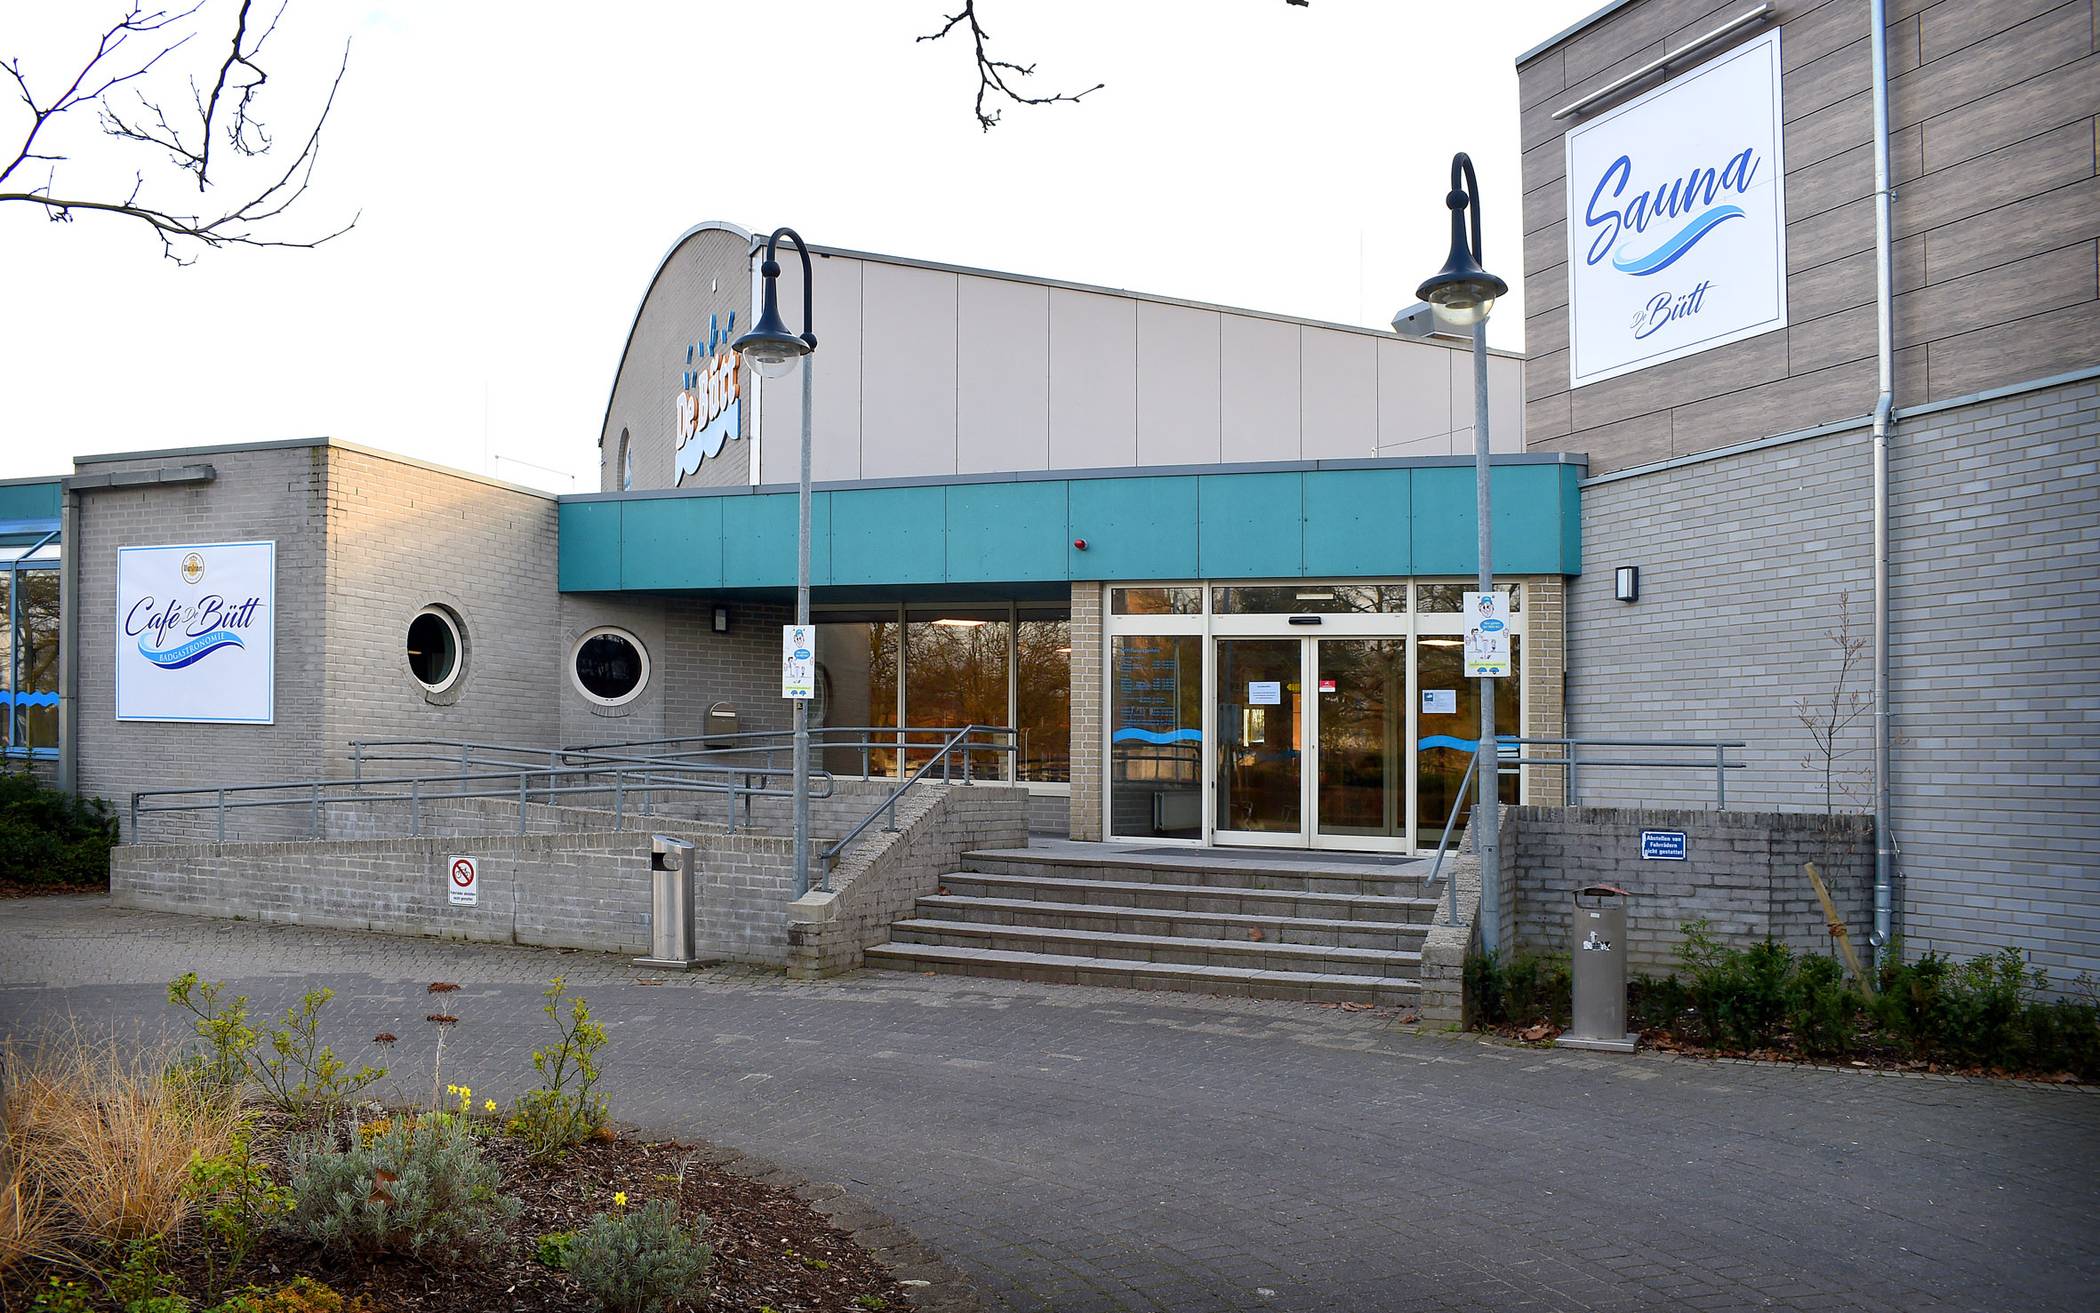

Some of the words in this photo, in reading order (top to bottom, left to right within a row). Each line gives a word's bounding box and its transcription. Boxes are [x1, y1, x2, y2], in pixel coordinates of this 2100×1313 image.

[1585, 147, 1761, 266] Sauna
[1629, 310, 1647, 329] De
[1634, 280, 1720, 340] Bütt
[675, 391, 699, 451] De
[697, 348, 741, 432] Bütt
[125, 595, 182, 648] Café
[182, 606, 199, 623] De
[185, 594, 267, 637] Bütt
[158, 631, 226, 663] BADGASTRONOMIE
